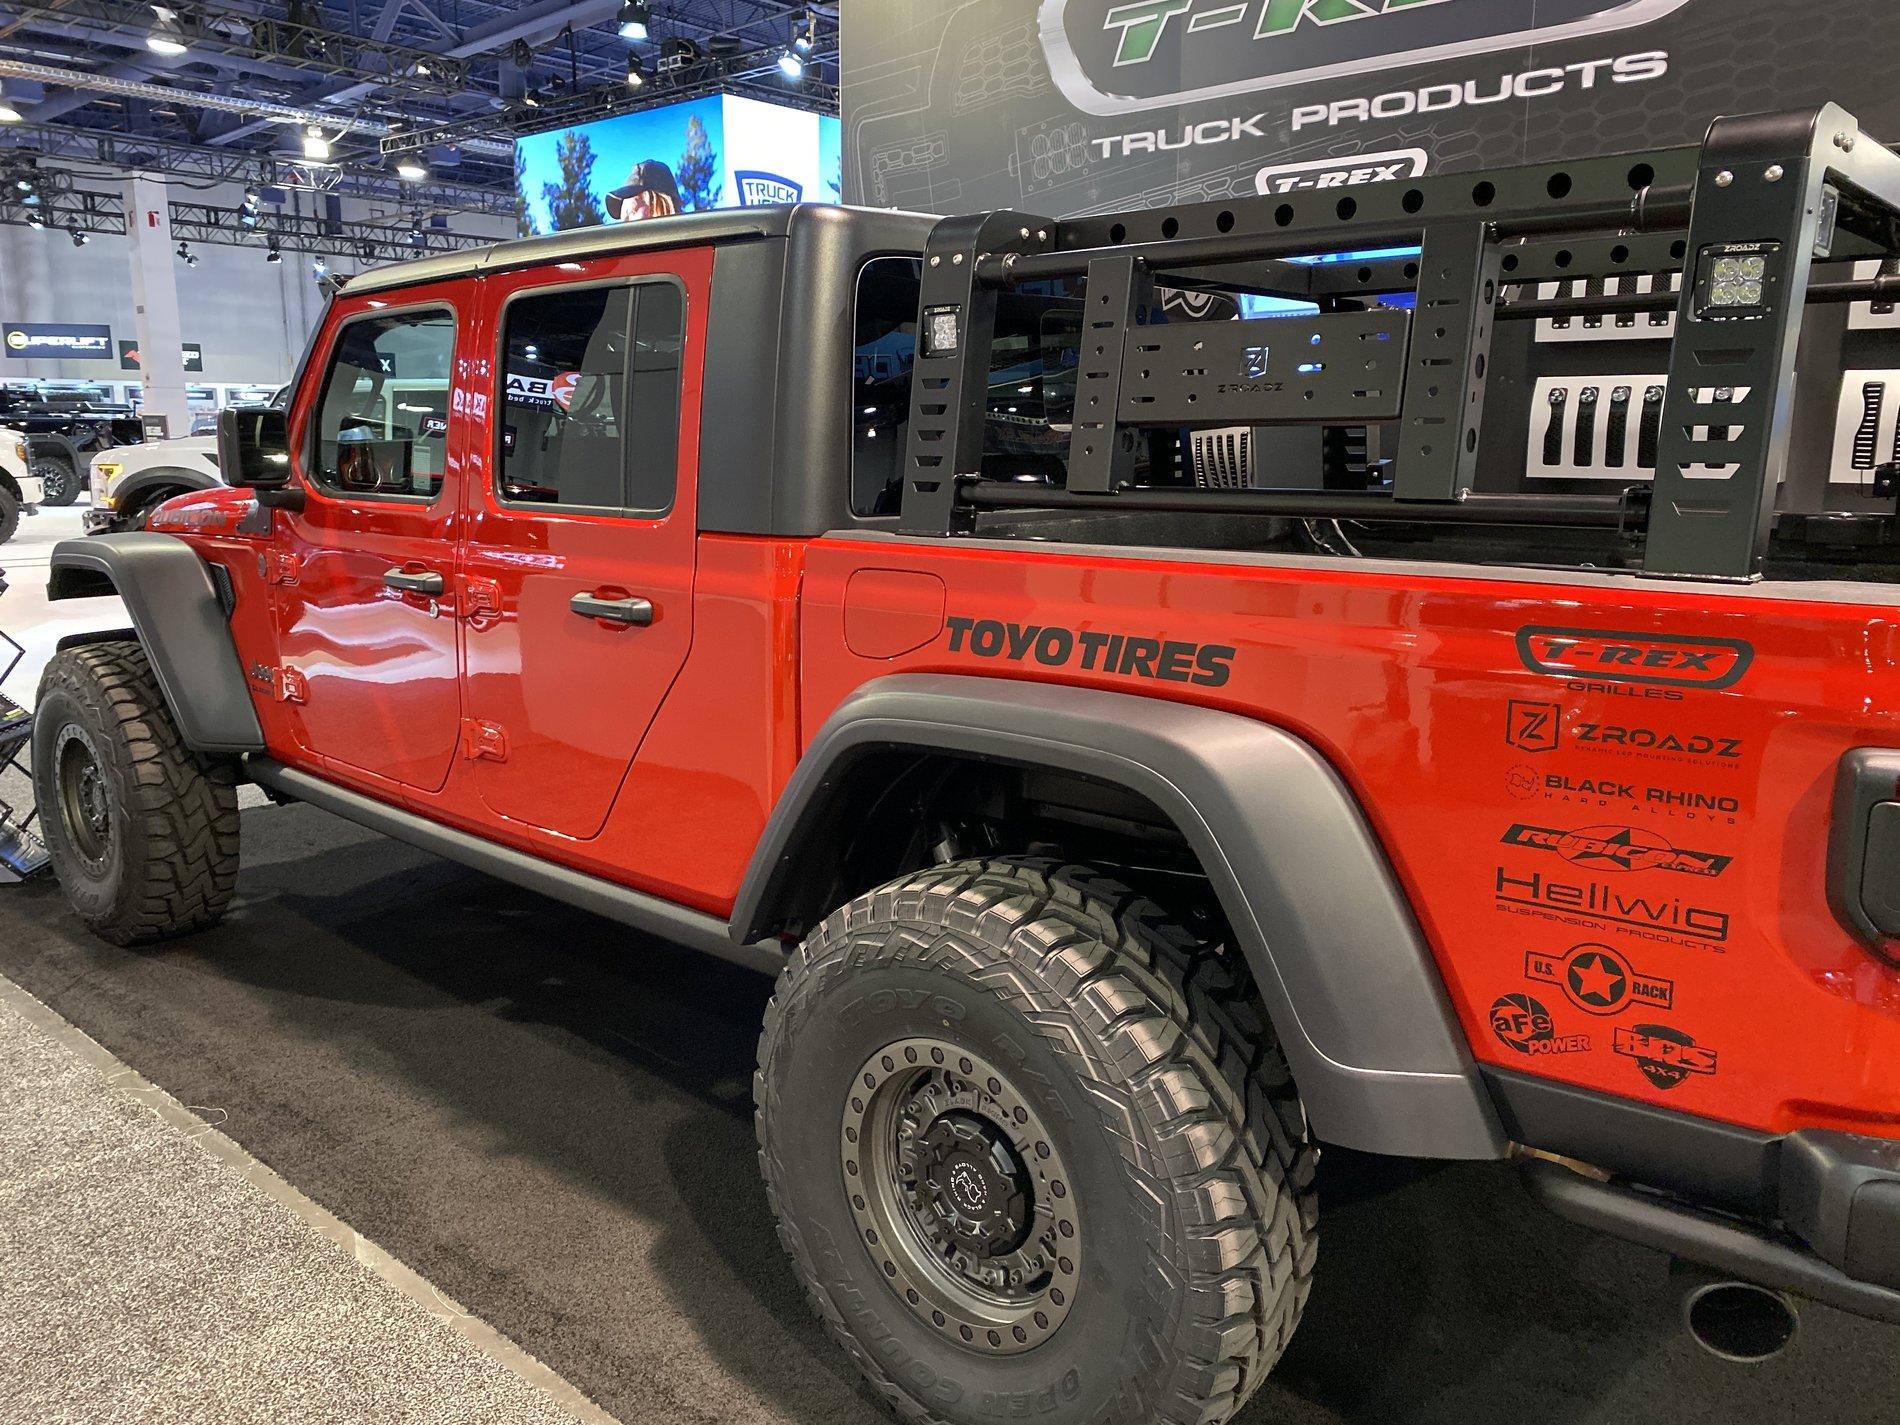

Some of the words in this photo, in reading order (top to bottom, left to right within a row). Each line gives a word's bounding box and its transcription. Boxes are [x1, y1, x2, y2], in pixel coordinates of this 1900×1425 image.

[1090, 112, 1268, 159] TRUCK
[1292, 50, 1668, 131] PRODUCTS
[745, 182, 794, 202] TRUCK
[946, 616, 1074, 666] TOYO
[1079, 631, 1236, 687] TIRES
[1541, 641, 1723, 672] T-REX
[1566, 681, 1683, 700] GRILLES
[1577, 723, 1743, 757] ZROADZ
[1544, 793, 1607, 806] HARD
[1632, 804, 1736, 824] ALLOYS
[1545, 774, 1635, 799] BLACK
[1645, 787, 1739, 813] RHINO
[1517, 828, 1716, 870] RUBICON
[1496, 866, 1730, 942] Hellwig
[1496, 904, 1607, 931] SUSPENSION
[1616, 926, 1726, 954] PRODUCTS
[1534, 960, 1556, 977] U.S.
[1632, 981, 1668, 1001] RACK
[1528, 1035, 1592, 1056] POWER
